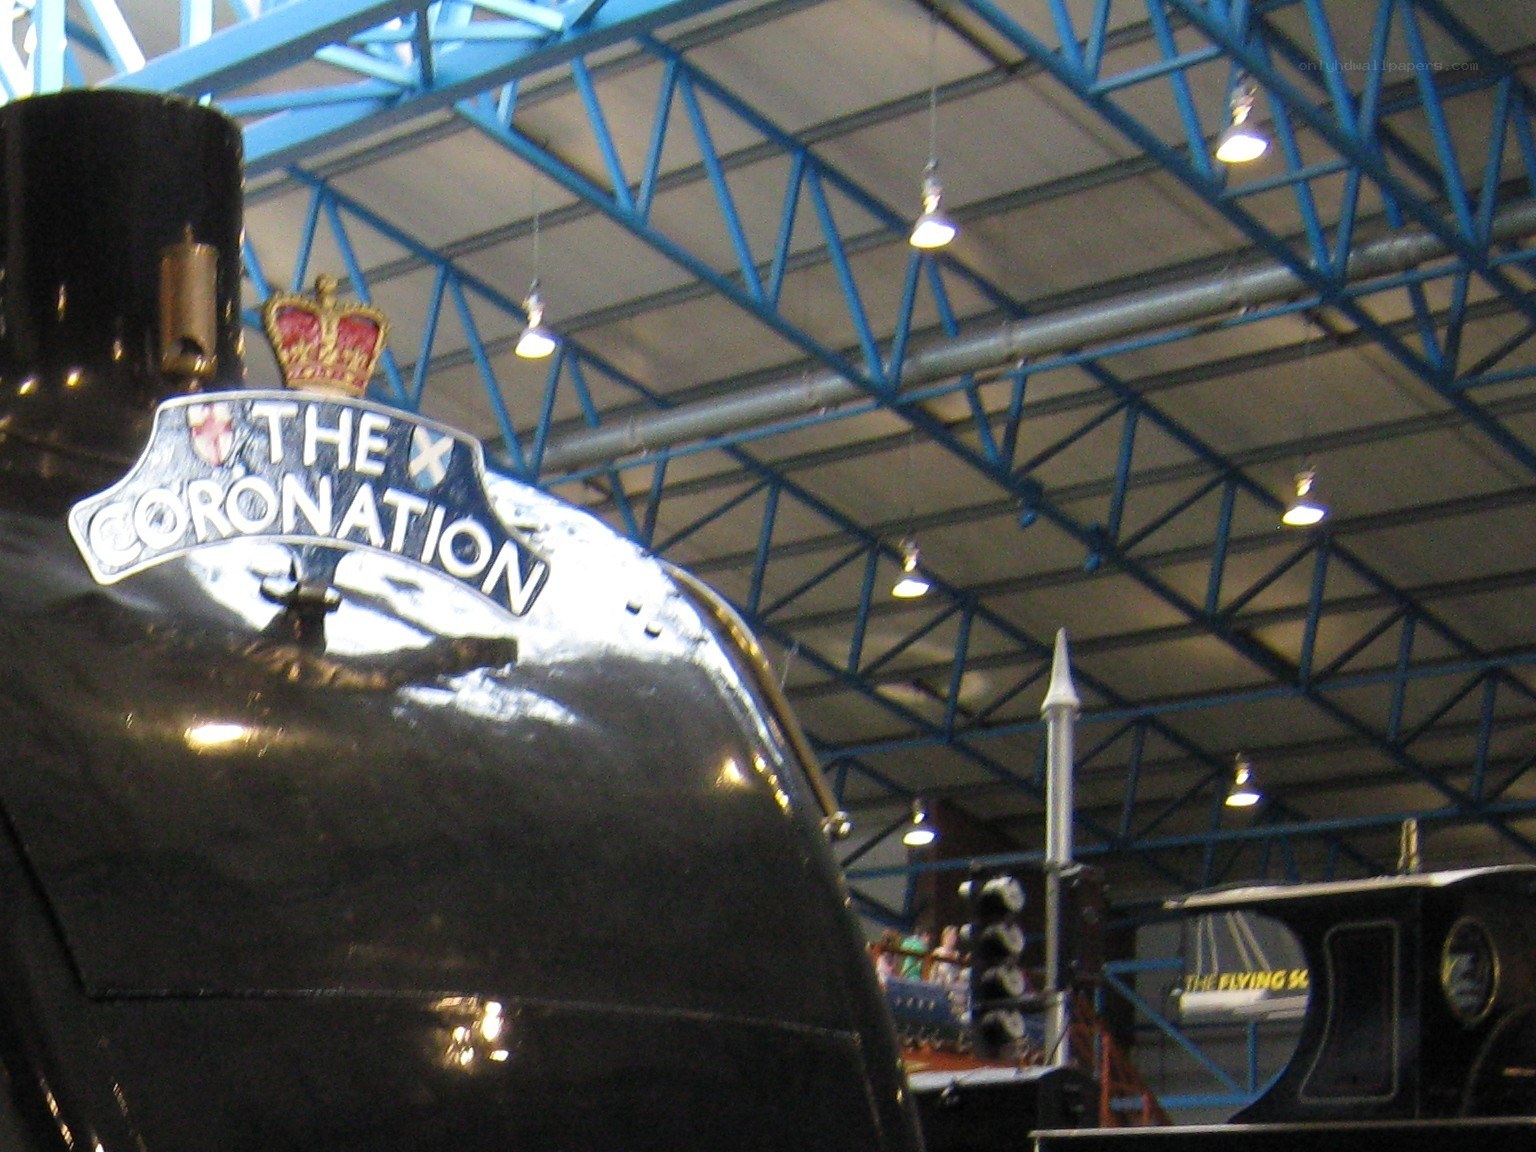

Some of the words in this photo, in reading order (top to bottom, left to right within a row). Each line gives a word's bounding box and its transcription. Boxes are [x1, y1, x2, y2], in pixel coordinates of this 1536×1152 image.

[251, 402, 392, 478] THE
[87, 472, 548, 616] CORONATION
[1218, 970, 1287, 991] FLYING
